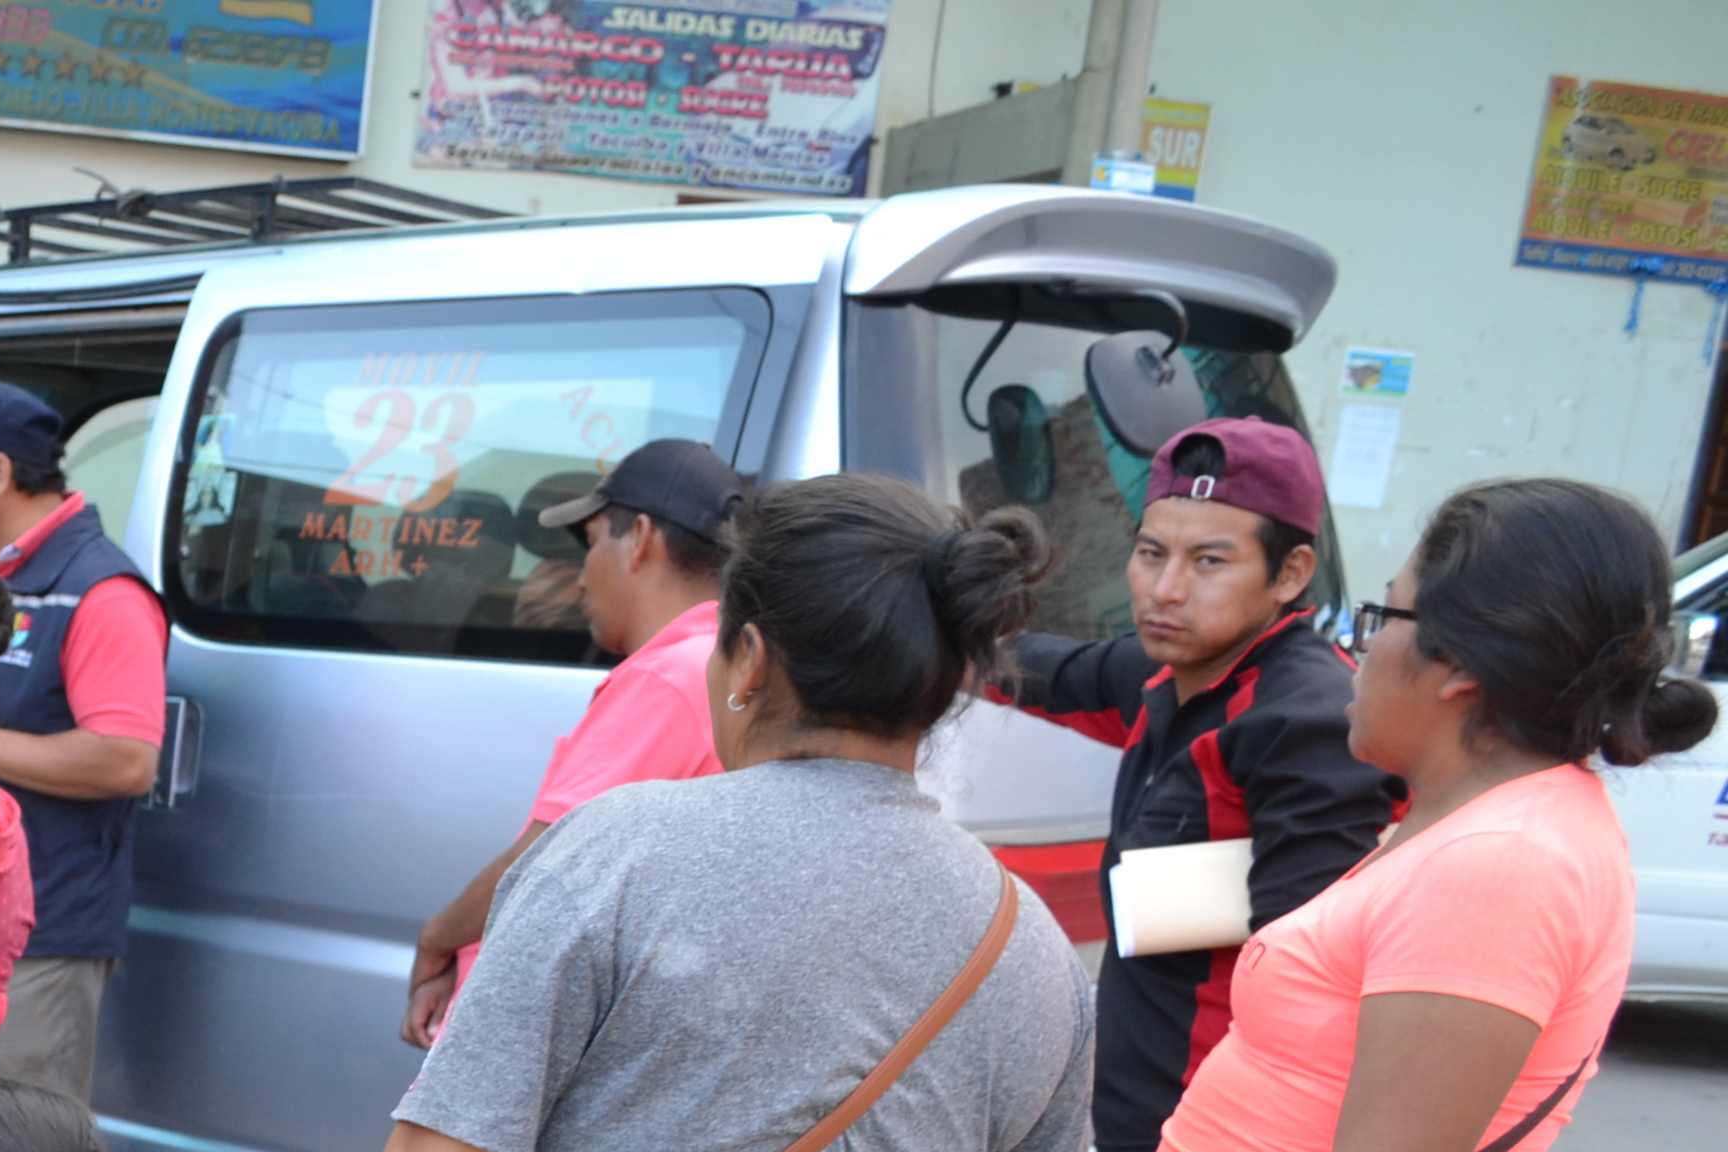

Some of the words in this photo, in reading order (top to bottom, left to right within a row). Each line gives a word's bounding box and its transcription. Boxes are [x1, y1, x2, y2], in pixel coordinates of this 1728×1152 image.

[602, 6, 737, 38] SALIDAS
[744, 18, 865, 50] DIARIAS
[1148, 125, 1202, 168] SUR
[353, 352, 486, 388] MOVIL
[324, 390, 475, 512] 23
[299, 512, 483, 546] MARTINEZ
